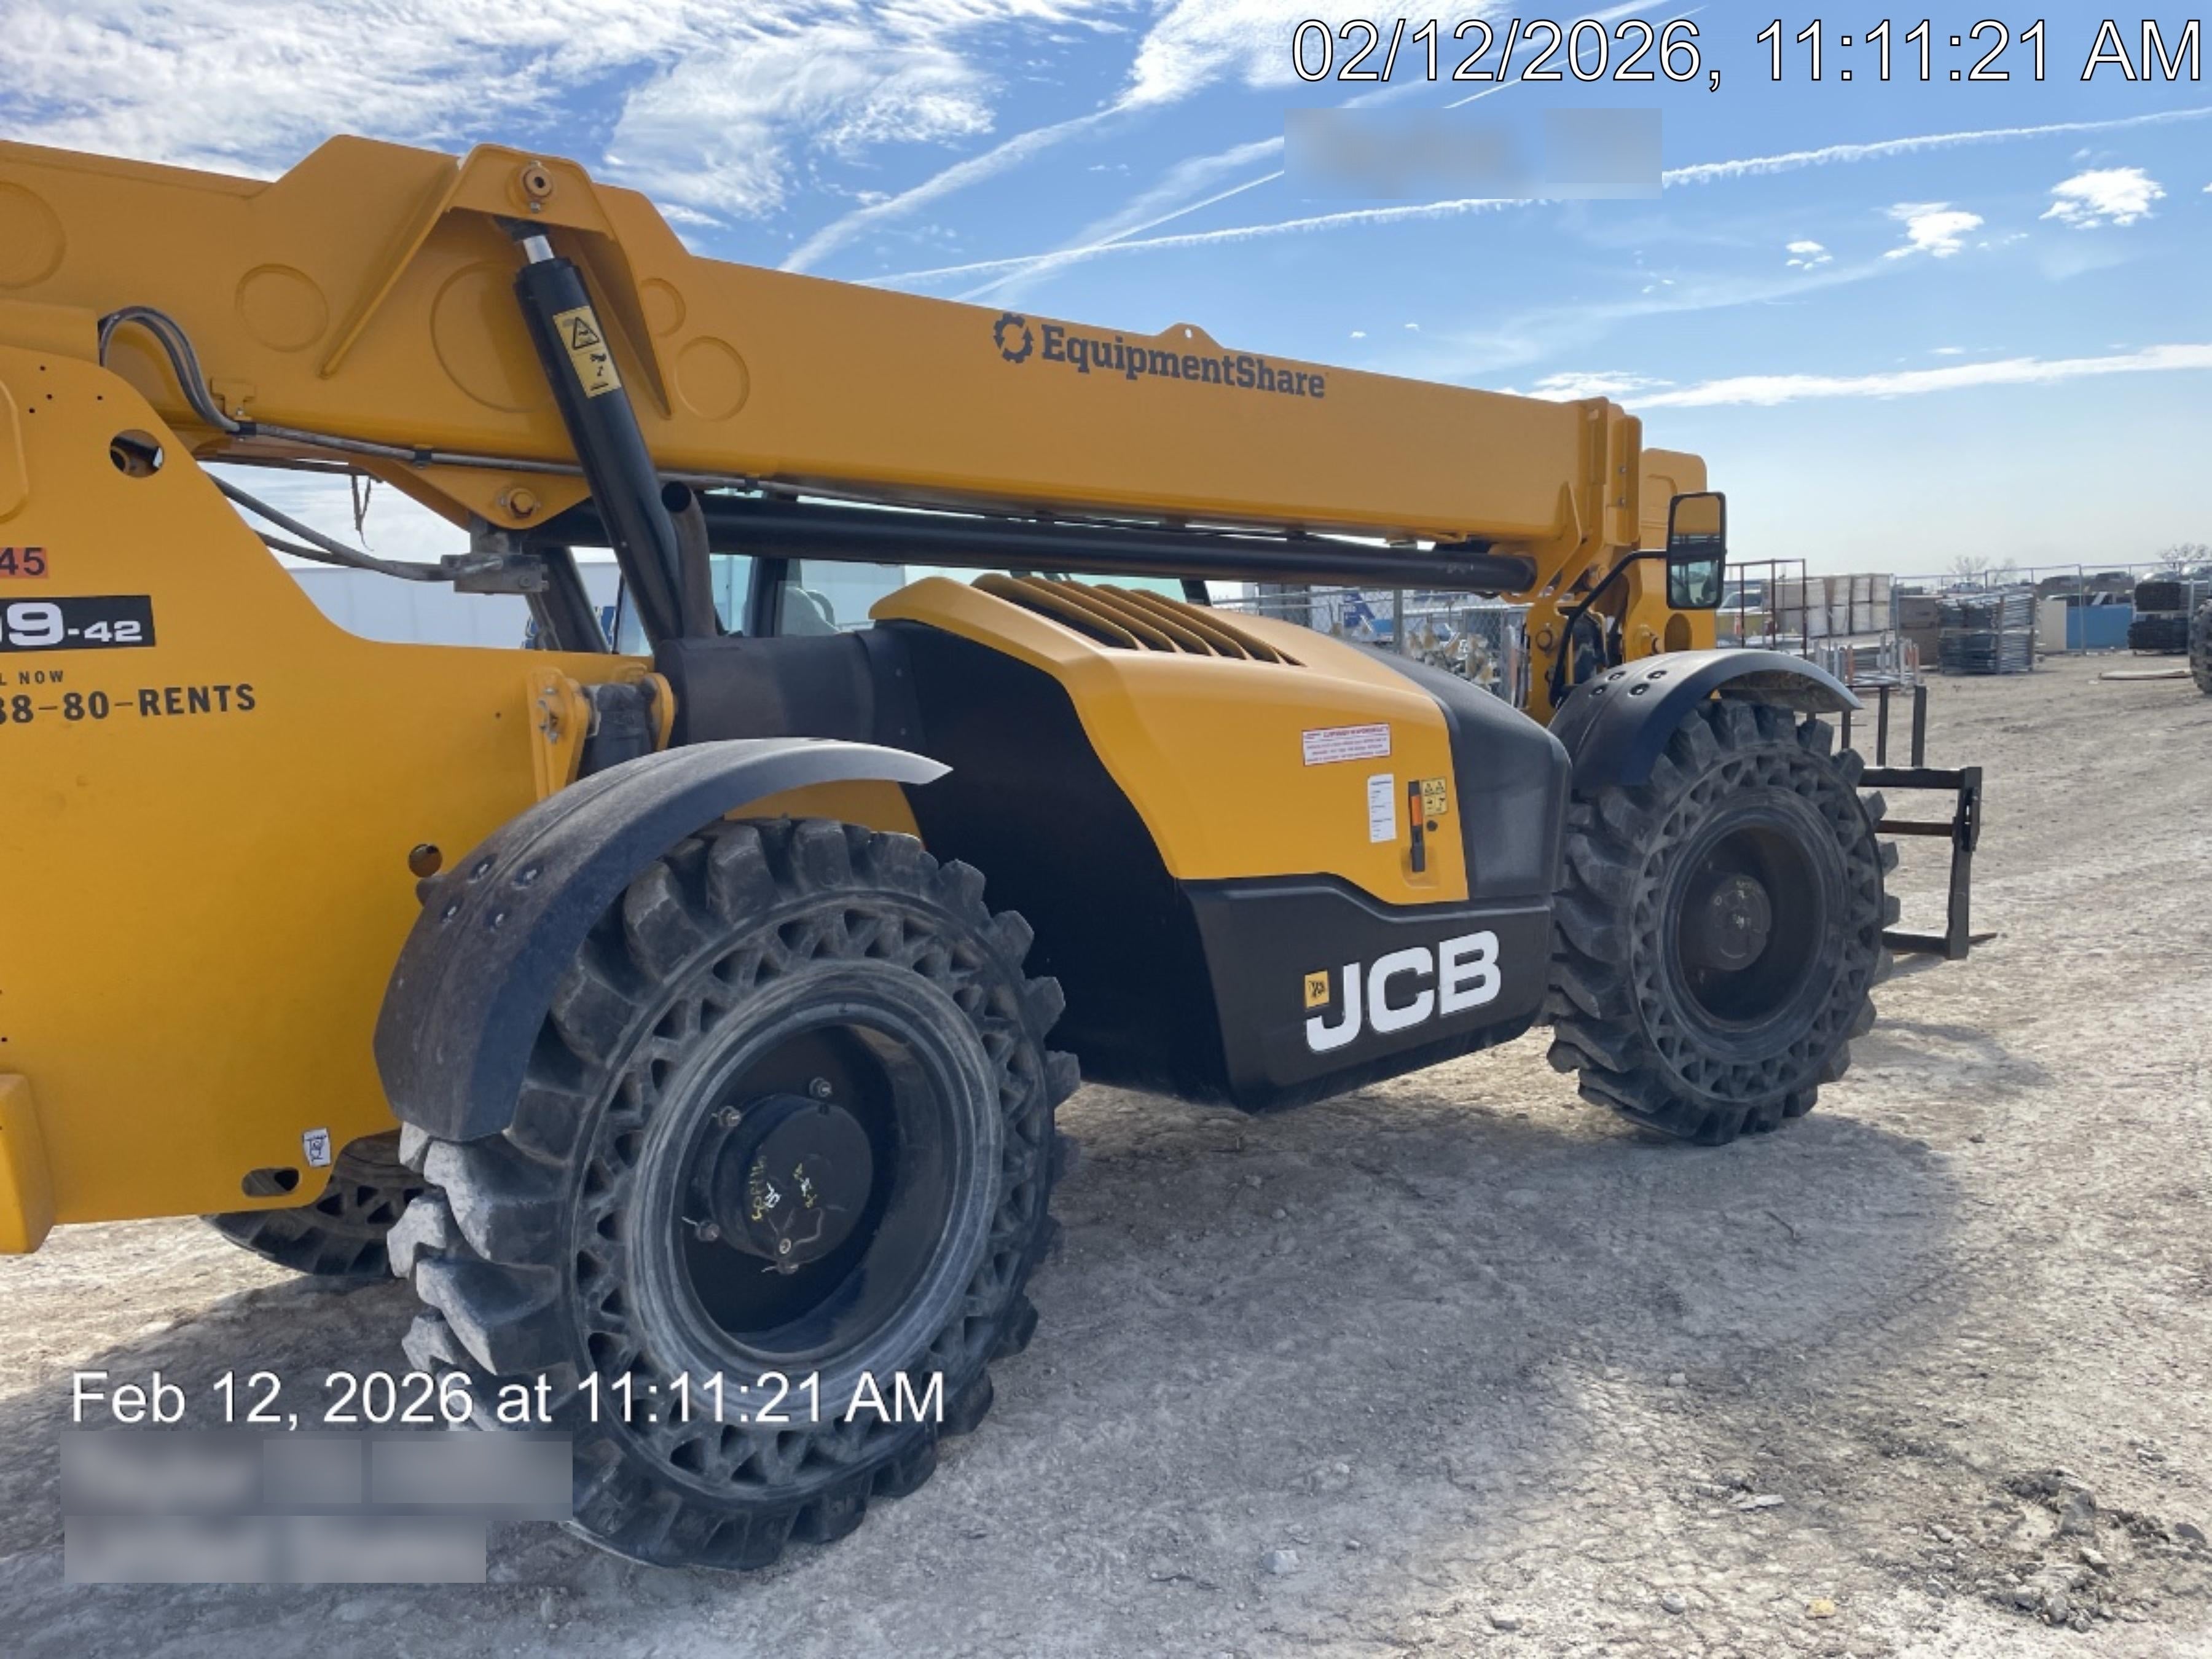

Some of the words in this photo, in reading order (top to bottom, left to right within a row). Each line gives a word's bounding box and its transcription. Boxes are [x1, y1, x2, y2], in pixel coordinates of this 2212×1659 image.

[1041, 323, 1325, 399] EquipmentShare
[0, 547, 45, 576] 45
[0, 602, 143, 646] 9-42
[18, 670, 64, 685] NOW
[1306, 930, 1502, 1054] JCB
